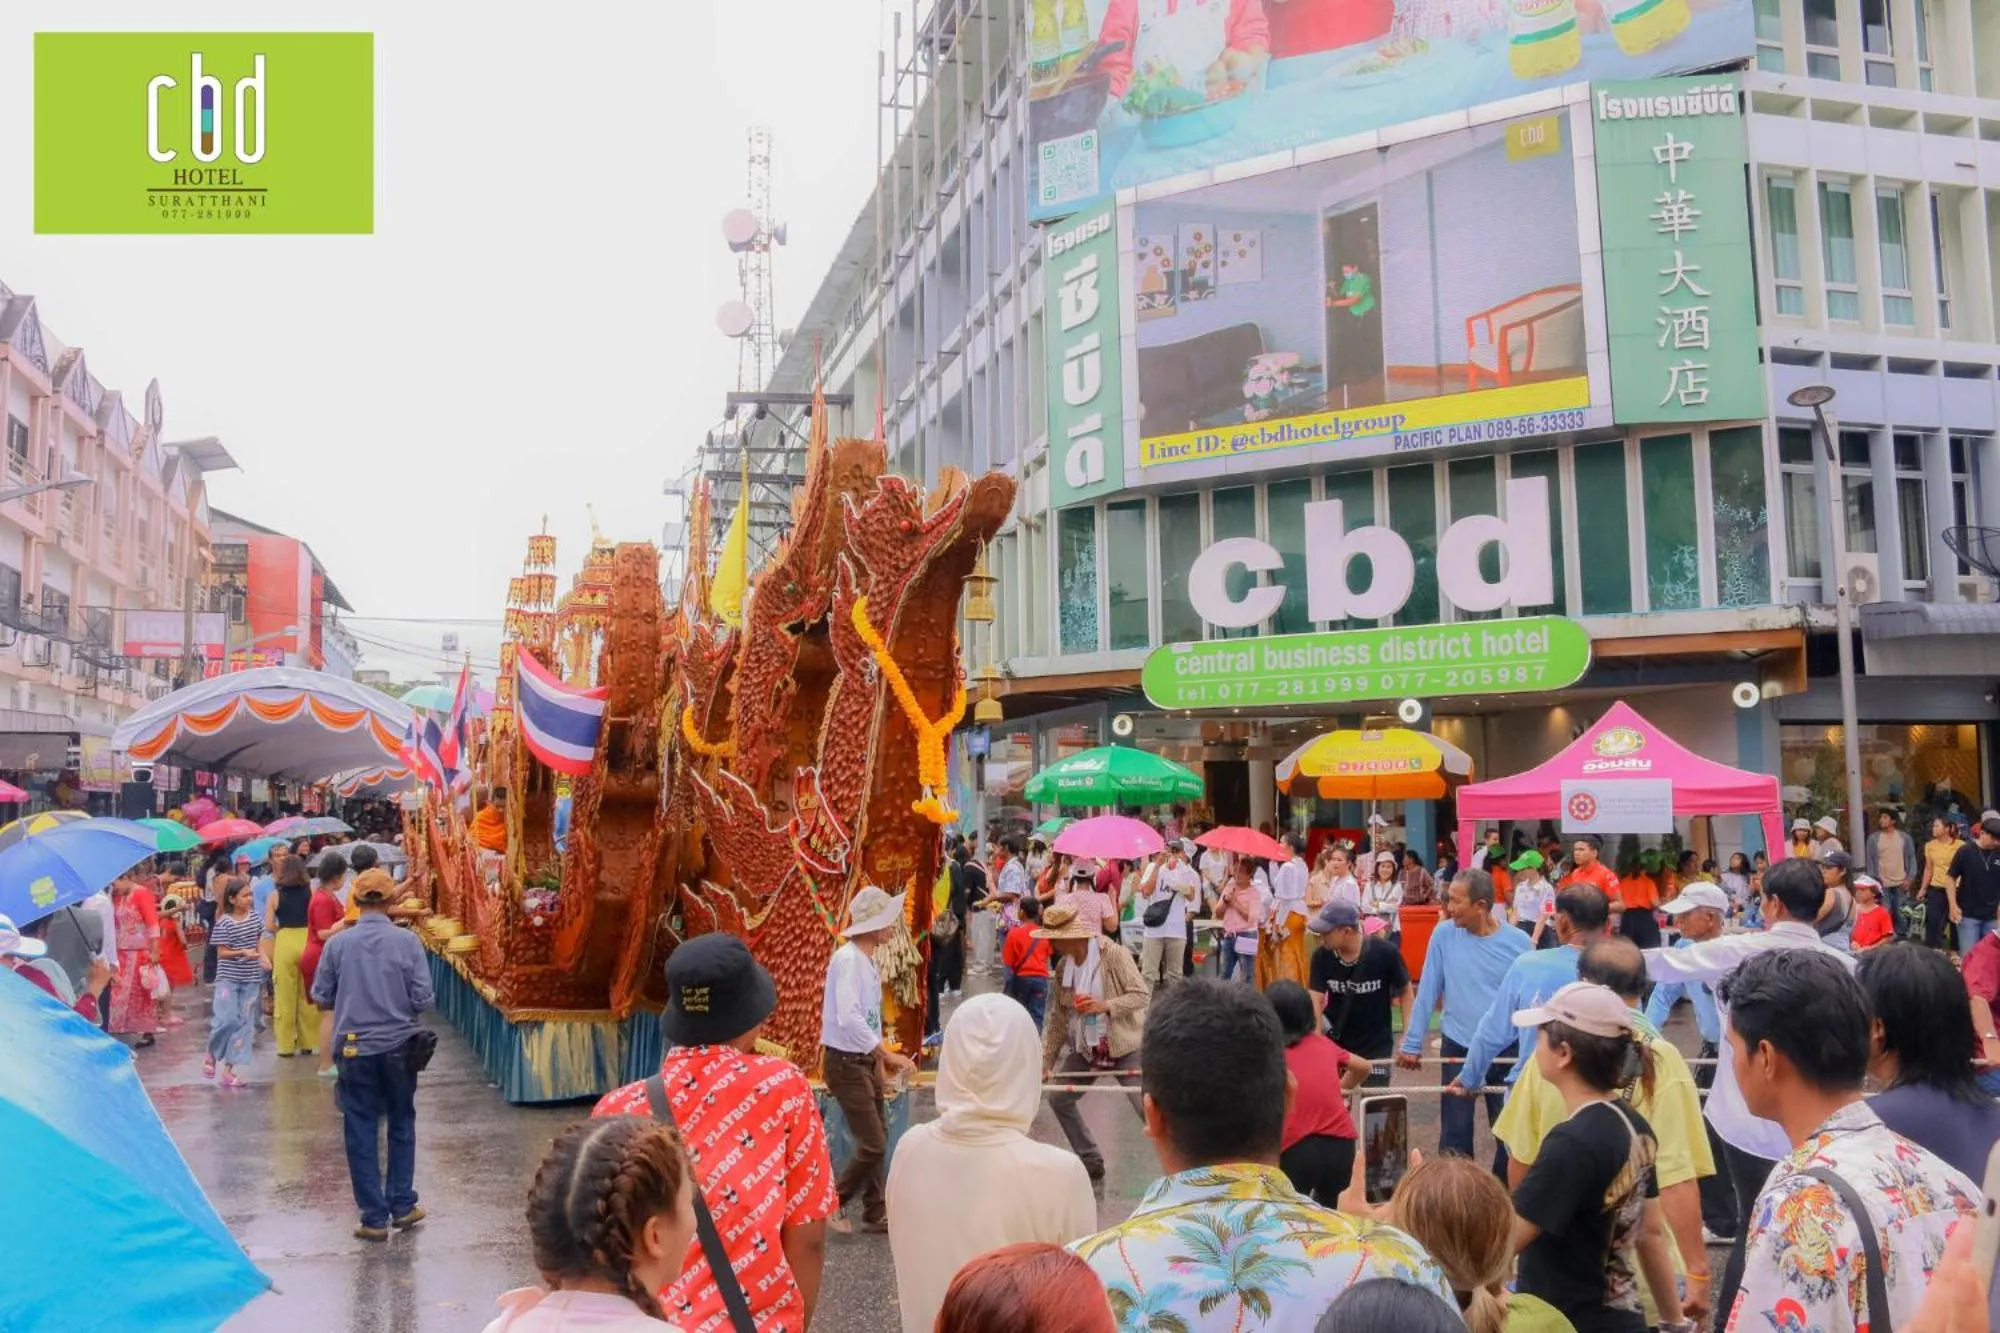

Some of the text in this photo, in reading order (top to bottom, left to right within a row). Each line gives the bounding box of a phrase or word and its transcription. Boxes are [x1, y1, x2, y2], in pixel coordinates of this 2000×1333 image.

[1649, 132, 1712, 408] 中華大酒店
[1149, 414, 1407, 461] Line ID: @cbdhotelgroup
[1394, 411, 1585, 450] PACIFIC PLAN 089-66-33333
[1188, 476, 1554, 628] cbd
[1175, 625, 1549, 676] central business district hotel
[1381, 666, 1546, 690] 077-205987
[704, 1093, 758, 1148] PLAYBOY
[742, 1137, 787, 1193] PLAYBO
[726, 1187, 781, 1243] PLAYBOY
